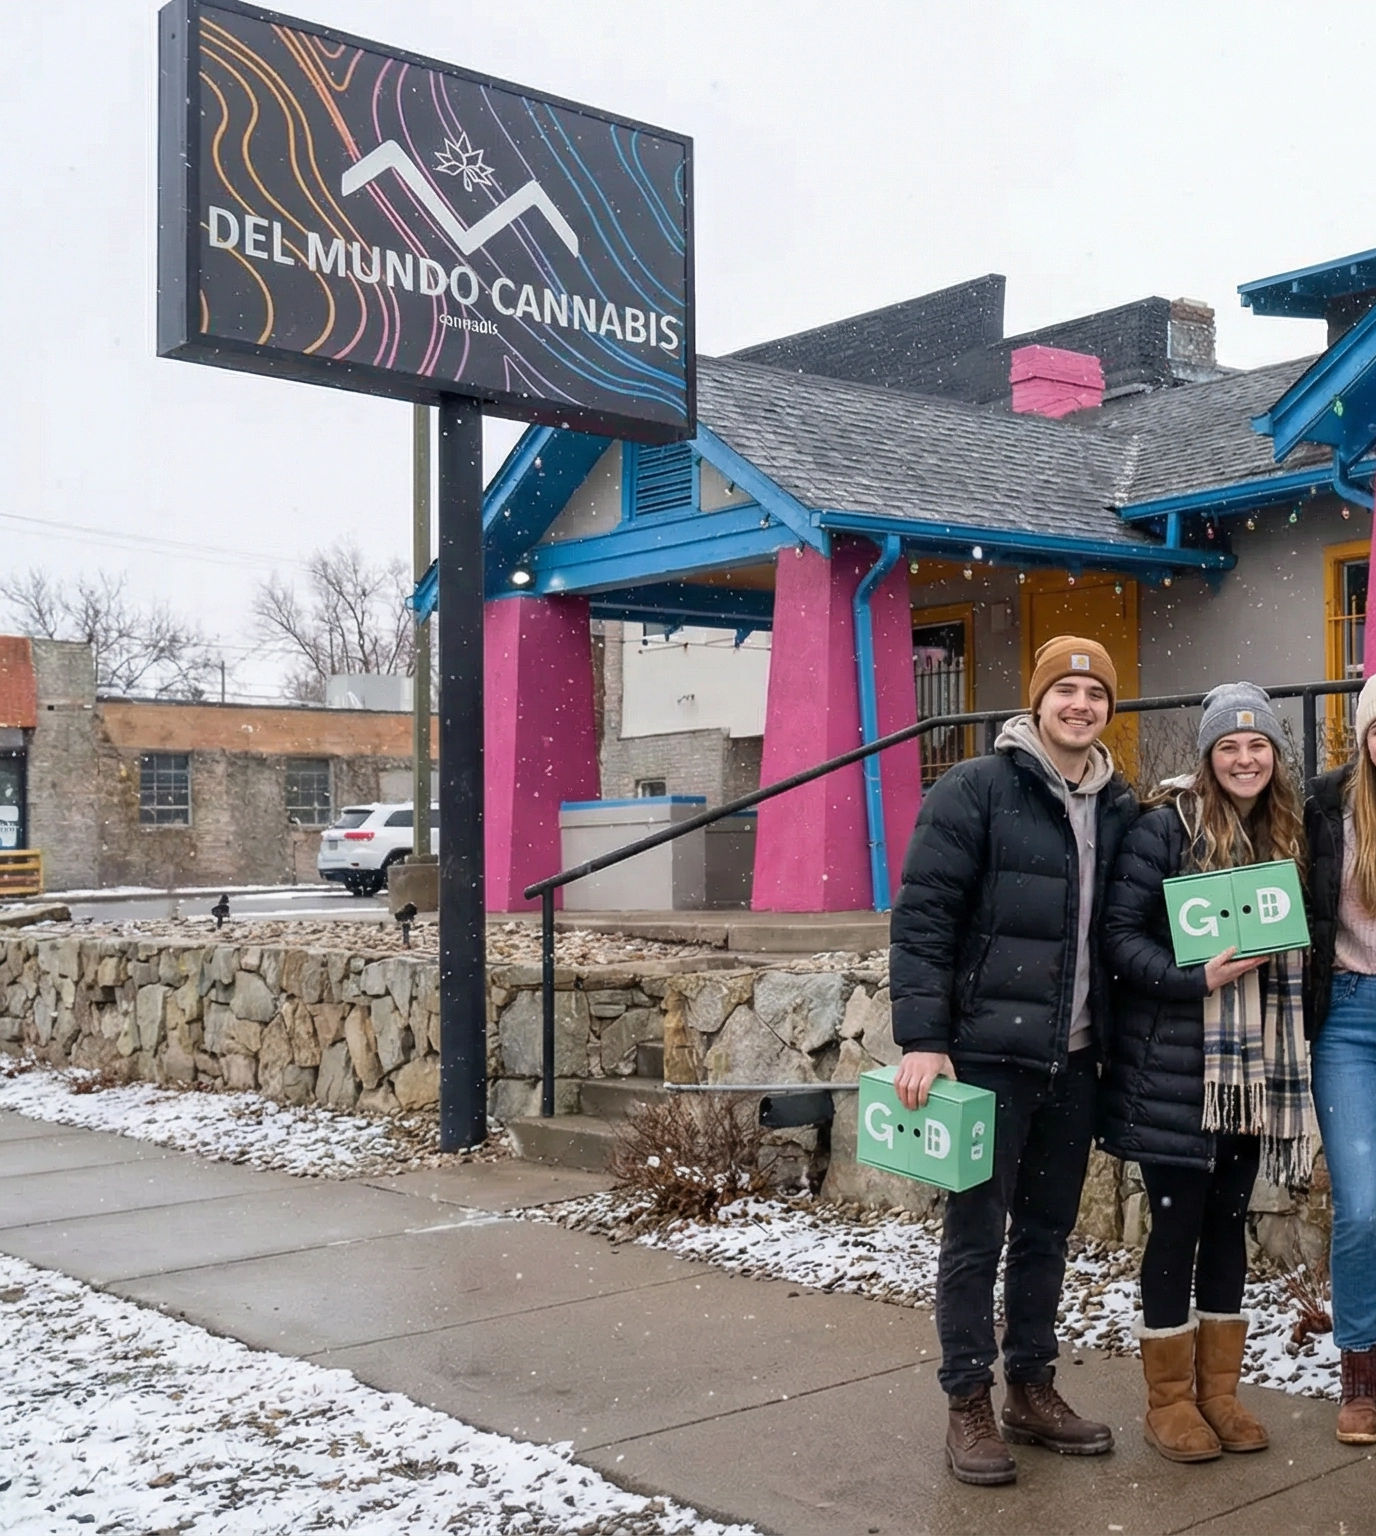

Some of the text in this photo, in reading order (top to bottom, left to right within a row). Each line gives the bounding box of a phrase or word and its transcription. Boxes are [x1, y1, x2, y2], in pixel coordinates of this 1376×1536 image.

[208, 205, 679, 350] DEL MUNDO CANNABIS
